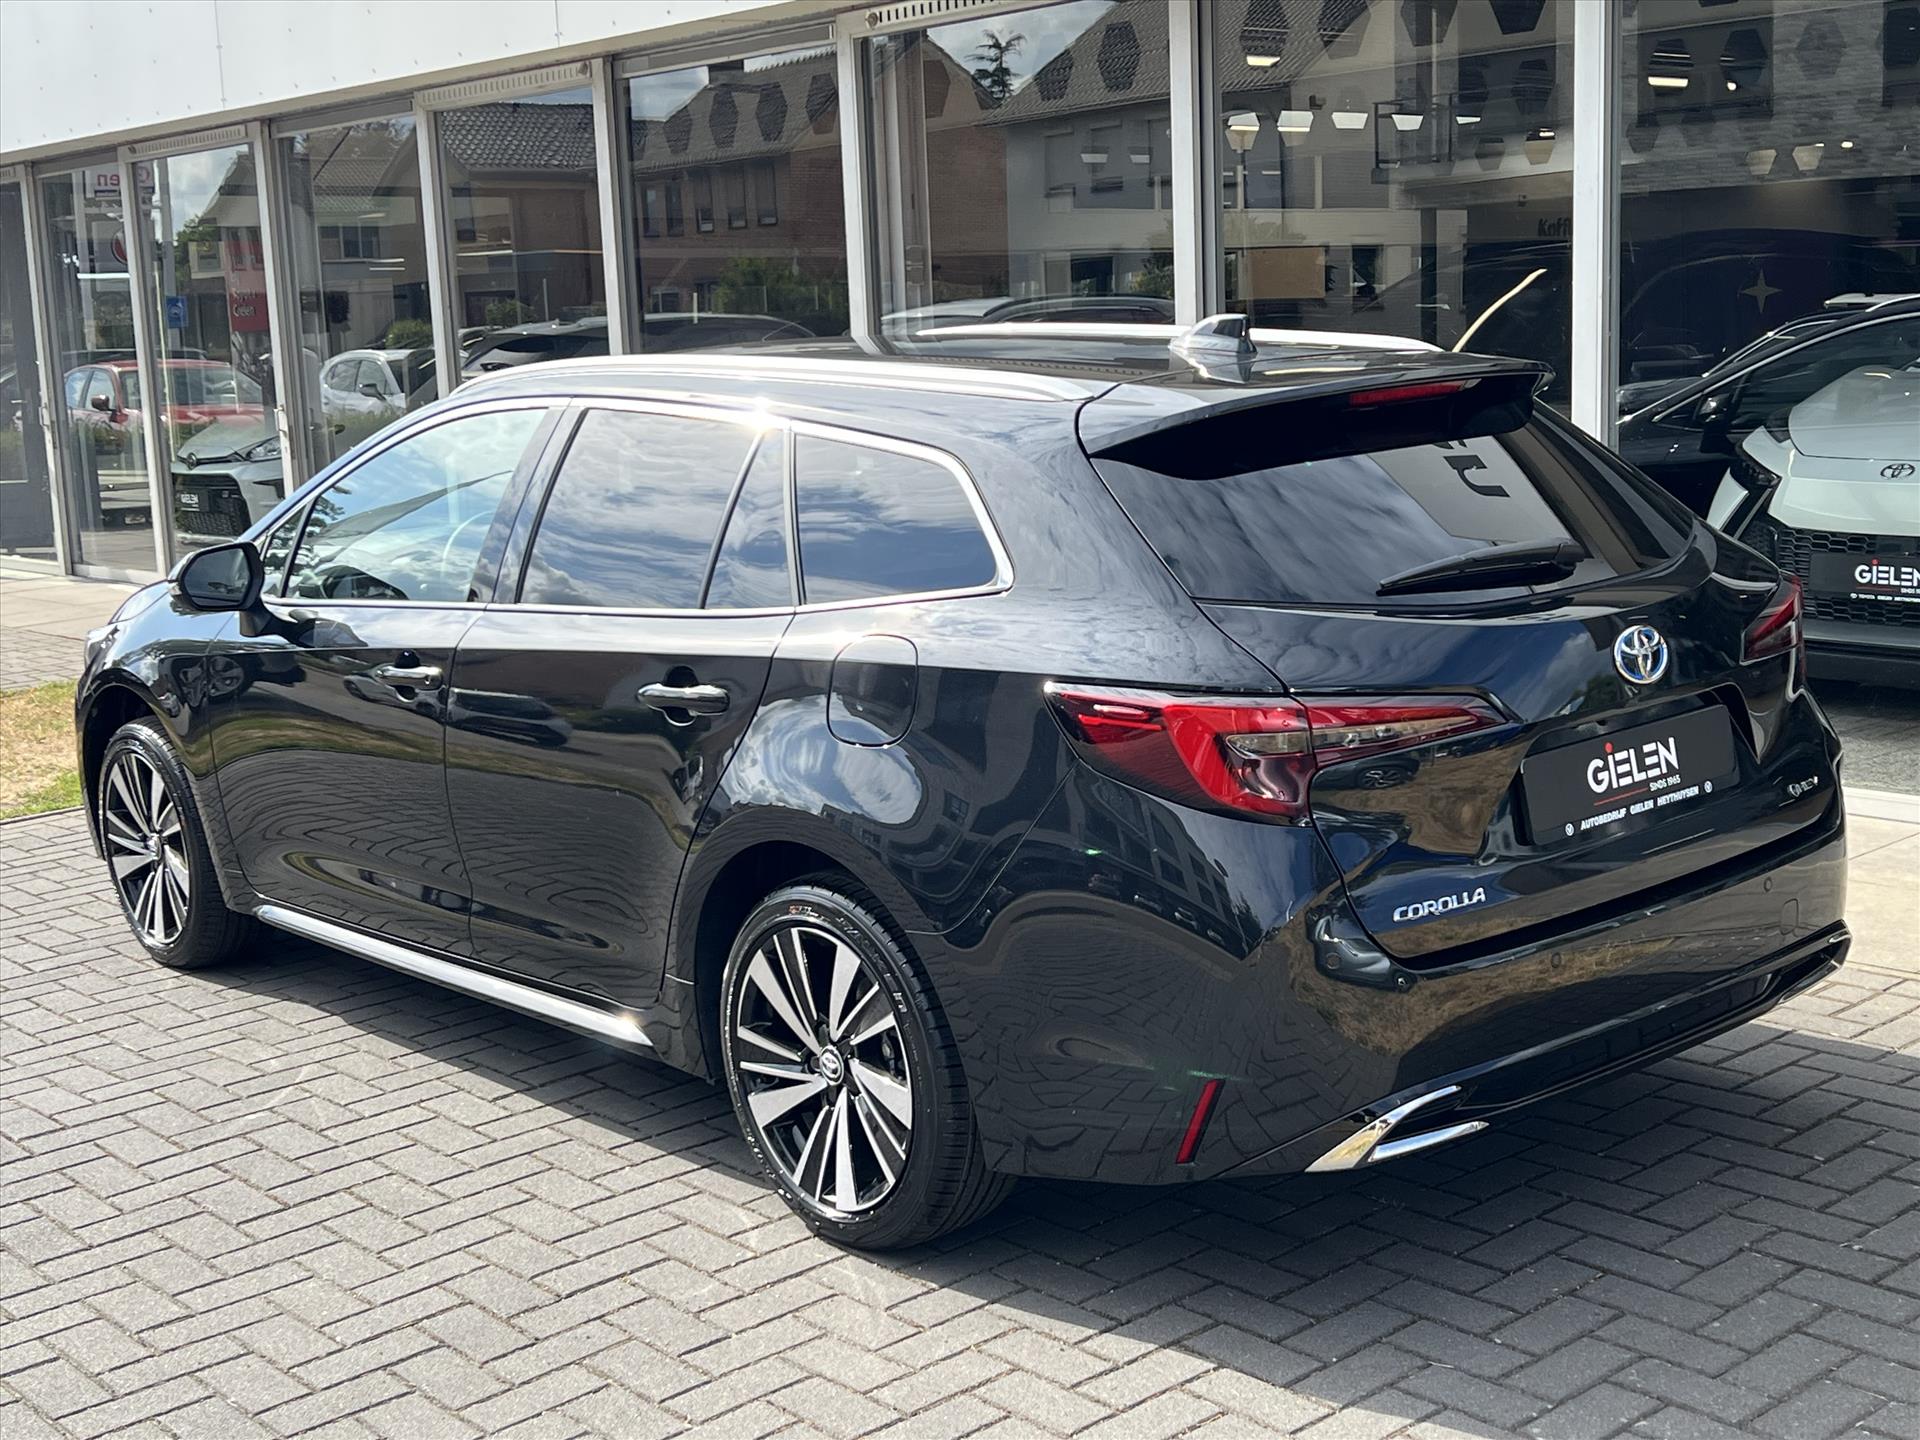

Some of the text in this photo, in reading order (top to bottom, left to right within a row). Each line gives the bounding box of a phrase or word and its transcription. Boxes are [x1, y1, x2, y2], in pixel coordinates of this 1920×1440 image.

[1586, 736, 1680, 794] GIELEN
[1649, 774, 1682, 792] SINDS 1965
[1580, 785, 1700, 831] AUTOBEDRIJF GIELEN HEYTHUYSEN
[1392, 887, 1487, 922] COROLLA
